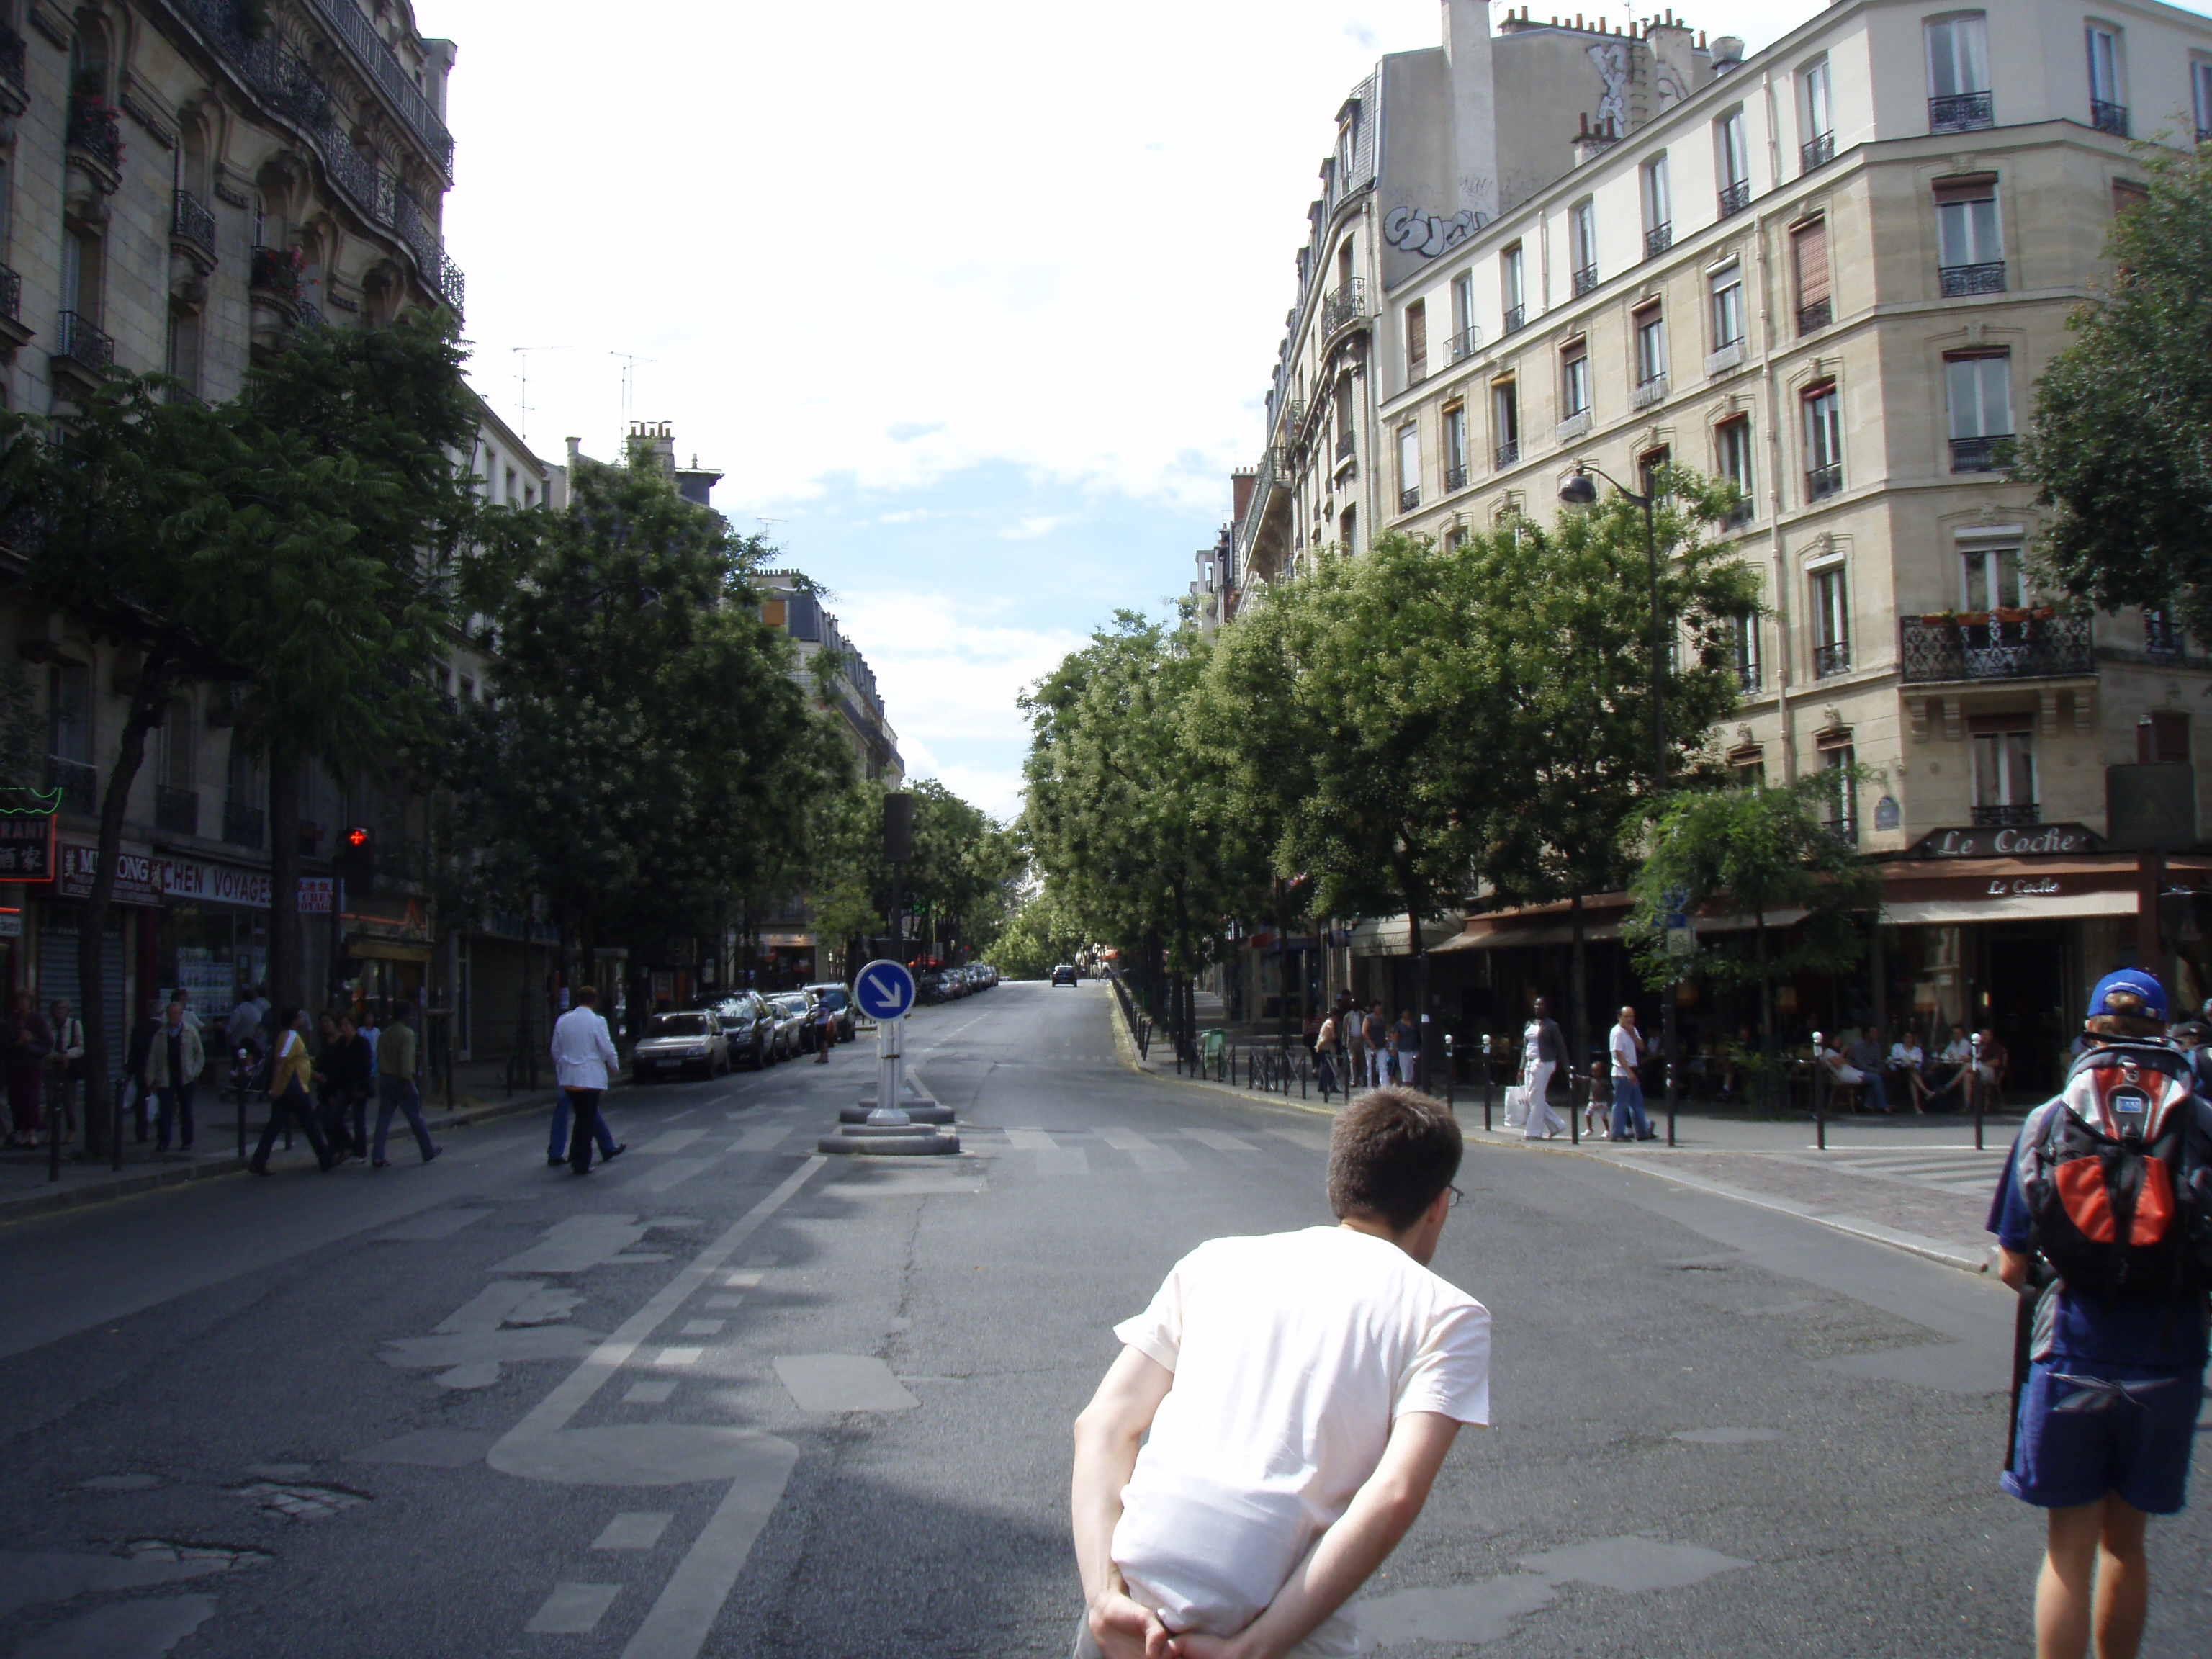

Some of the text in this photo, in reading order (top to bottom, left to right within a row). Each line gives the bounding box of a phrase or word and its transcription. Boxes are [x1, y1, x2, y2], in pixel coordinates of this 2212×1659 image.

[1938, 827, 2075, 855] Le Coche
[164, 860, 204, 894] CHEN
[1987, 880, 2008, 894] Le
